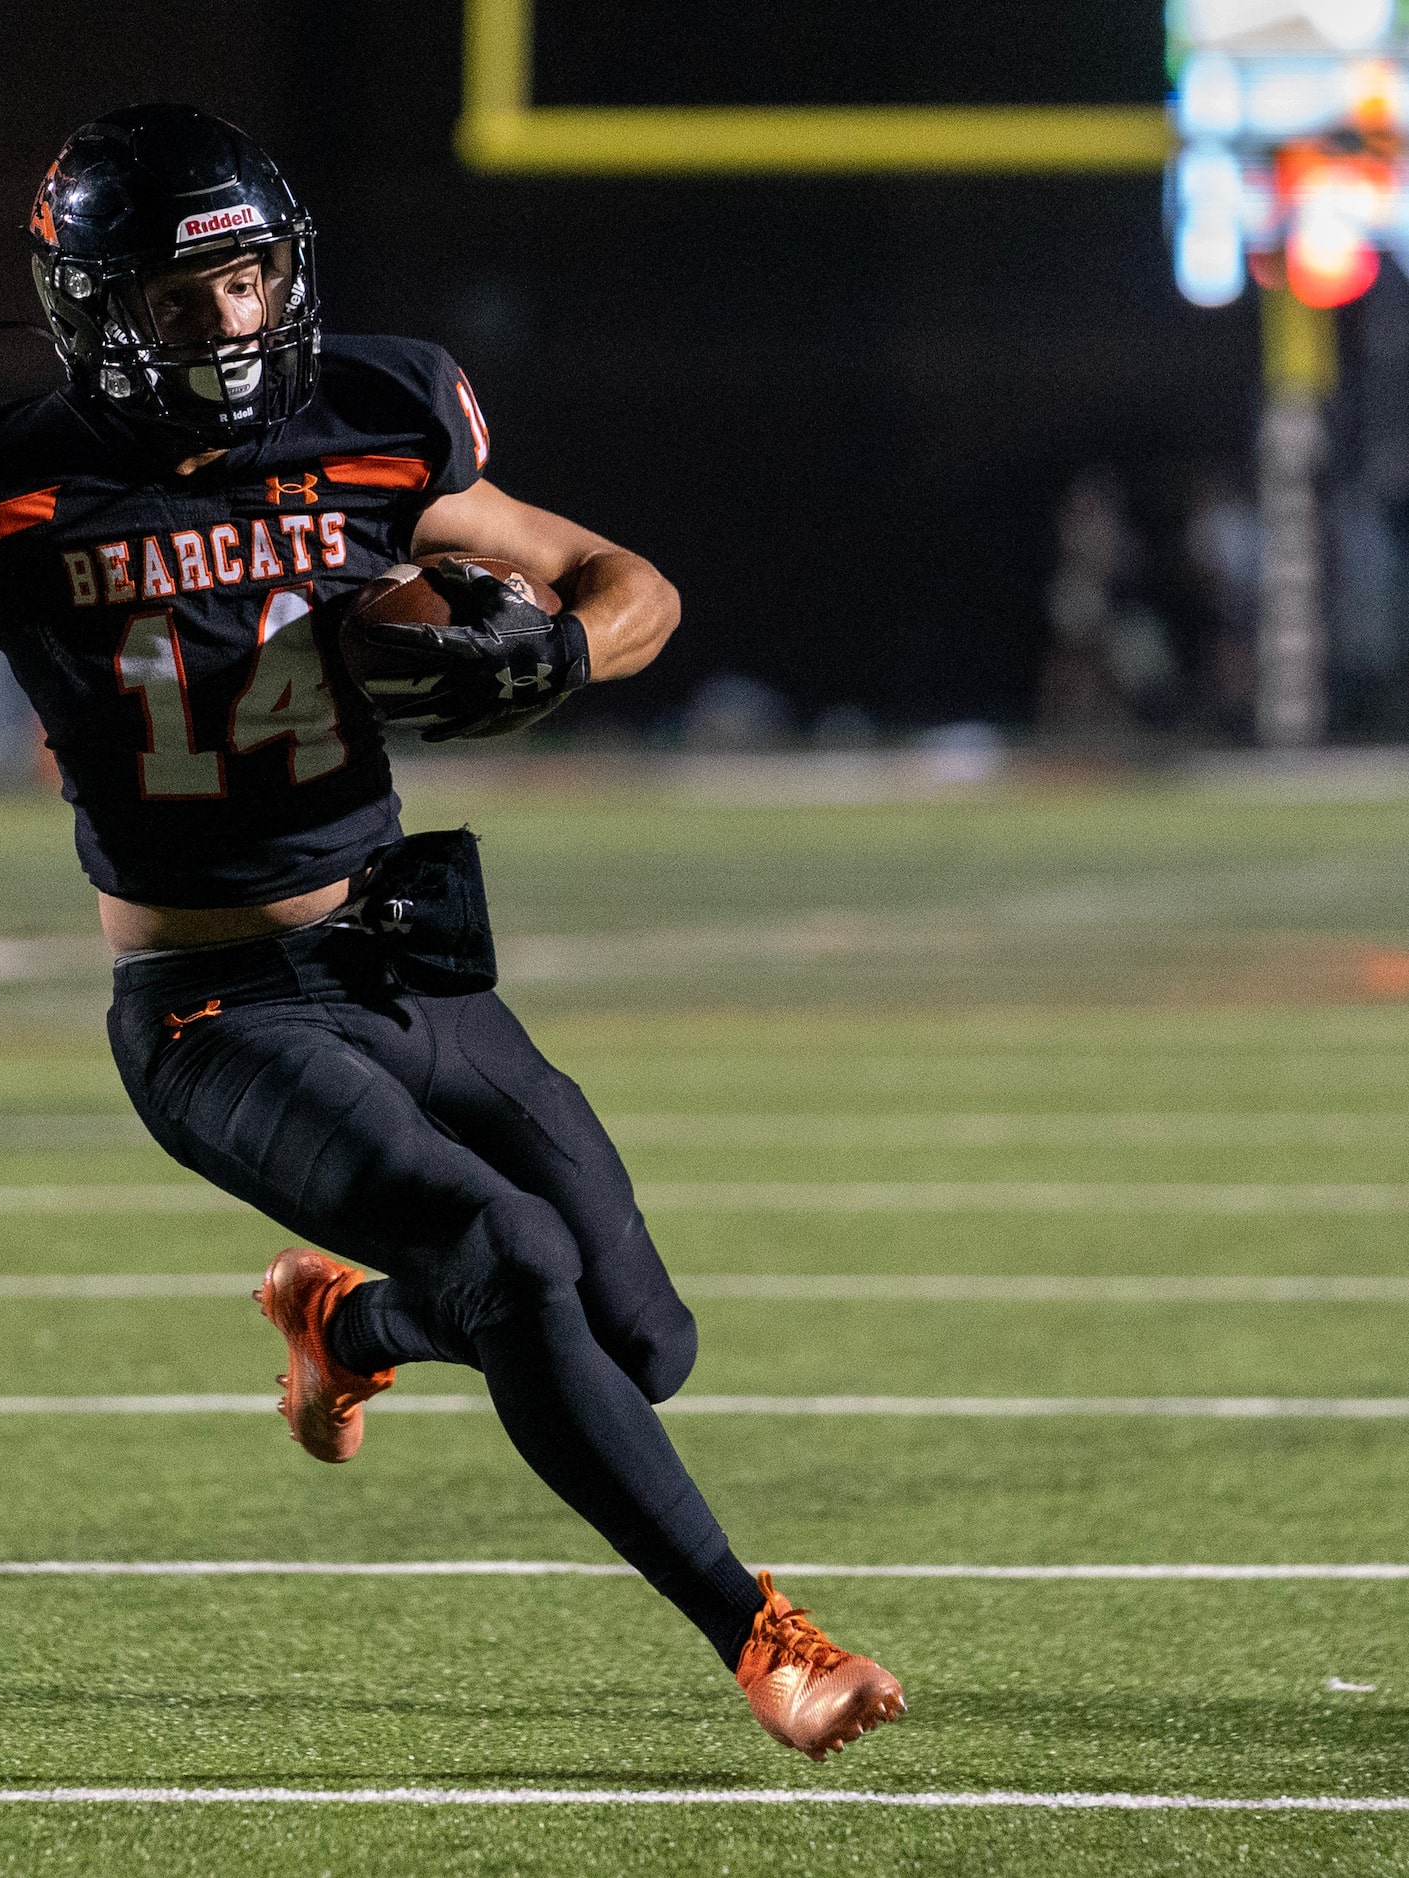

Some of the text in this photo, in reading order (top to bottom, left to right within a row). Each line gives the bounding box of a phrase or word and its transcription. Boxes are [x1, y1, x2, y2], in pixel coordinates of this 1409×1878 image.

[184, 208, 254, 236] Riddell
[219, 406, 254, 422] Rddell
[63, 511, 347, 606] BEARCATS
[113, 580, 349, 800] 14
